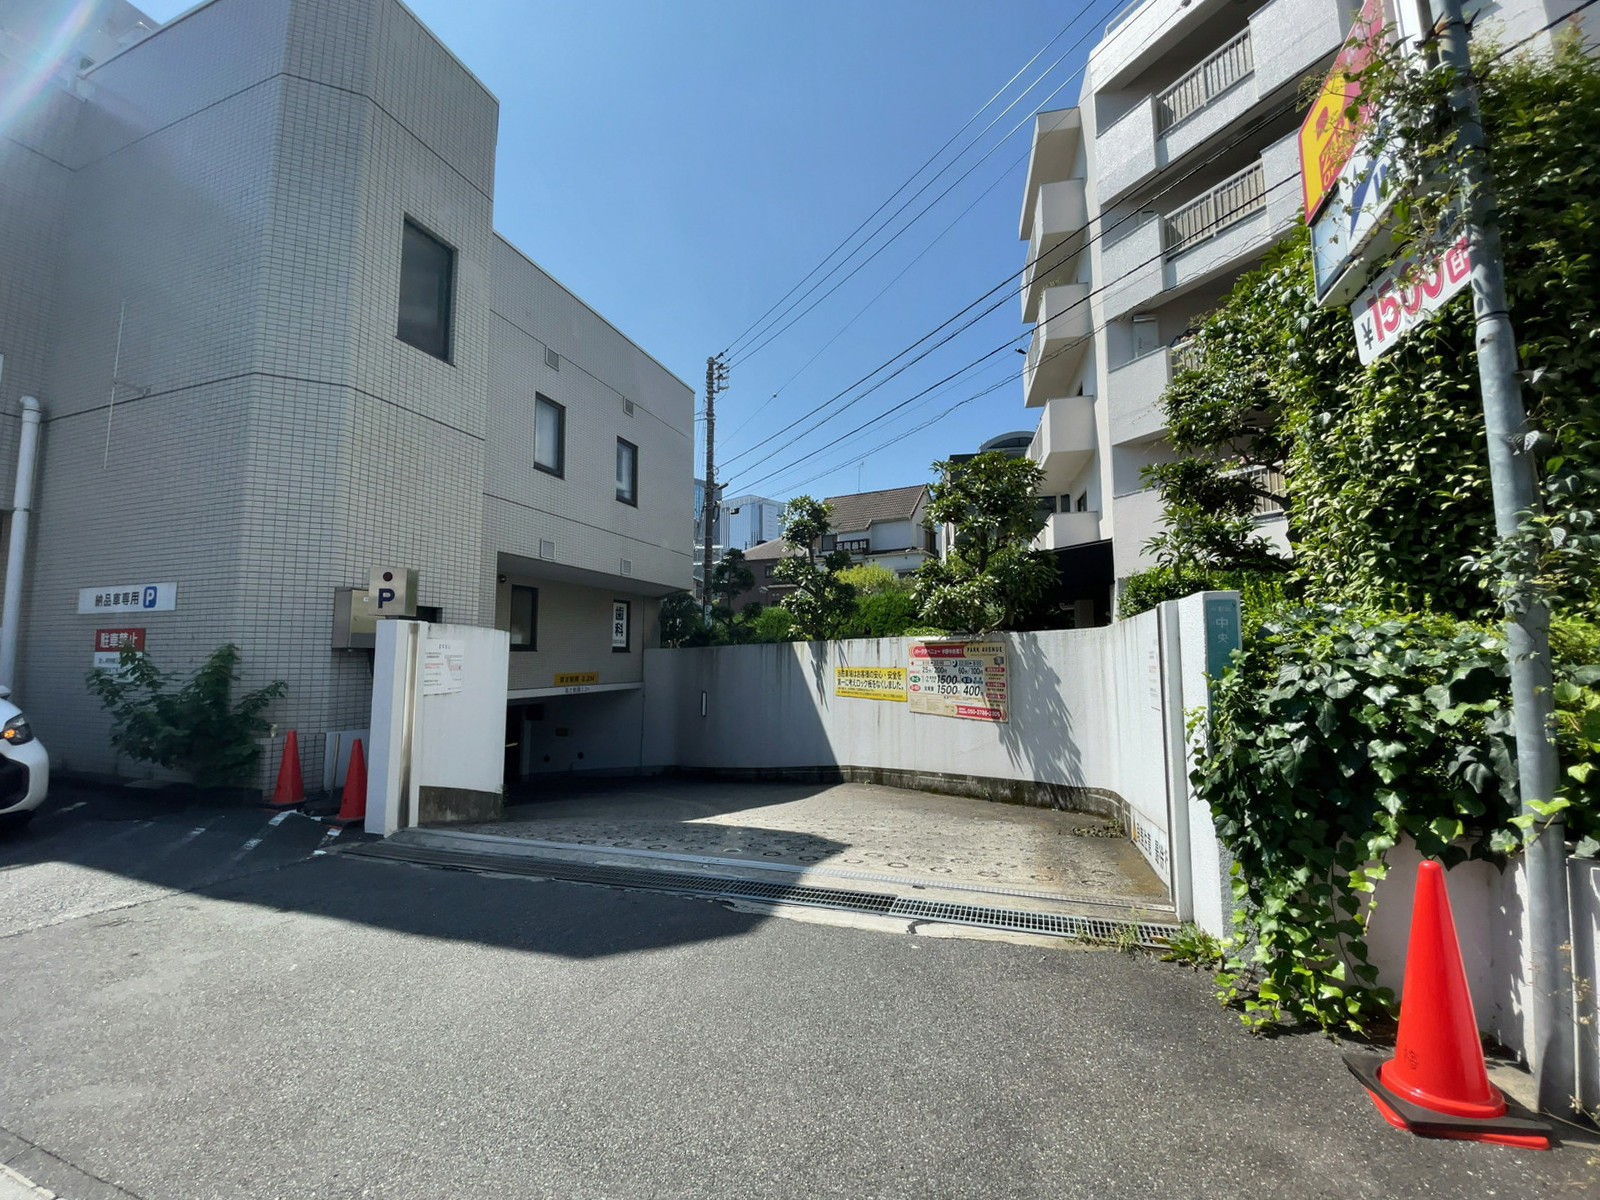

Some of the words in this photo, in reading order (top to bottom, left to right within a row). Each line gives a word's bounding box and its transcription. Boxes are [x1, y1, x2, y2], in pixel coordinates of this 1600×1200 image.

[94, 591, 140, 607] 納品車専用
[378, 588, 395, 609] P
[615, 605, 625, 637] 歯科
[1215, 616, 1229, 643] 中央
